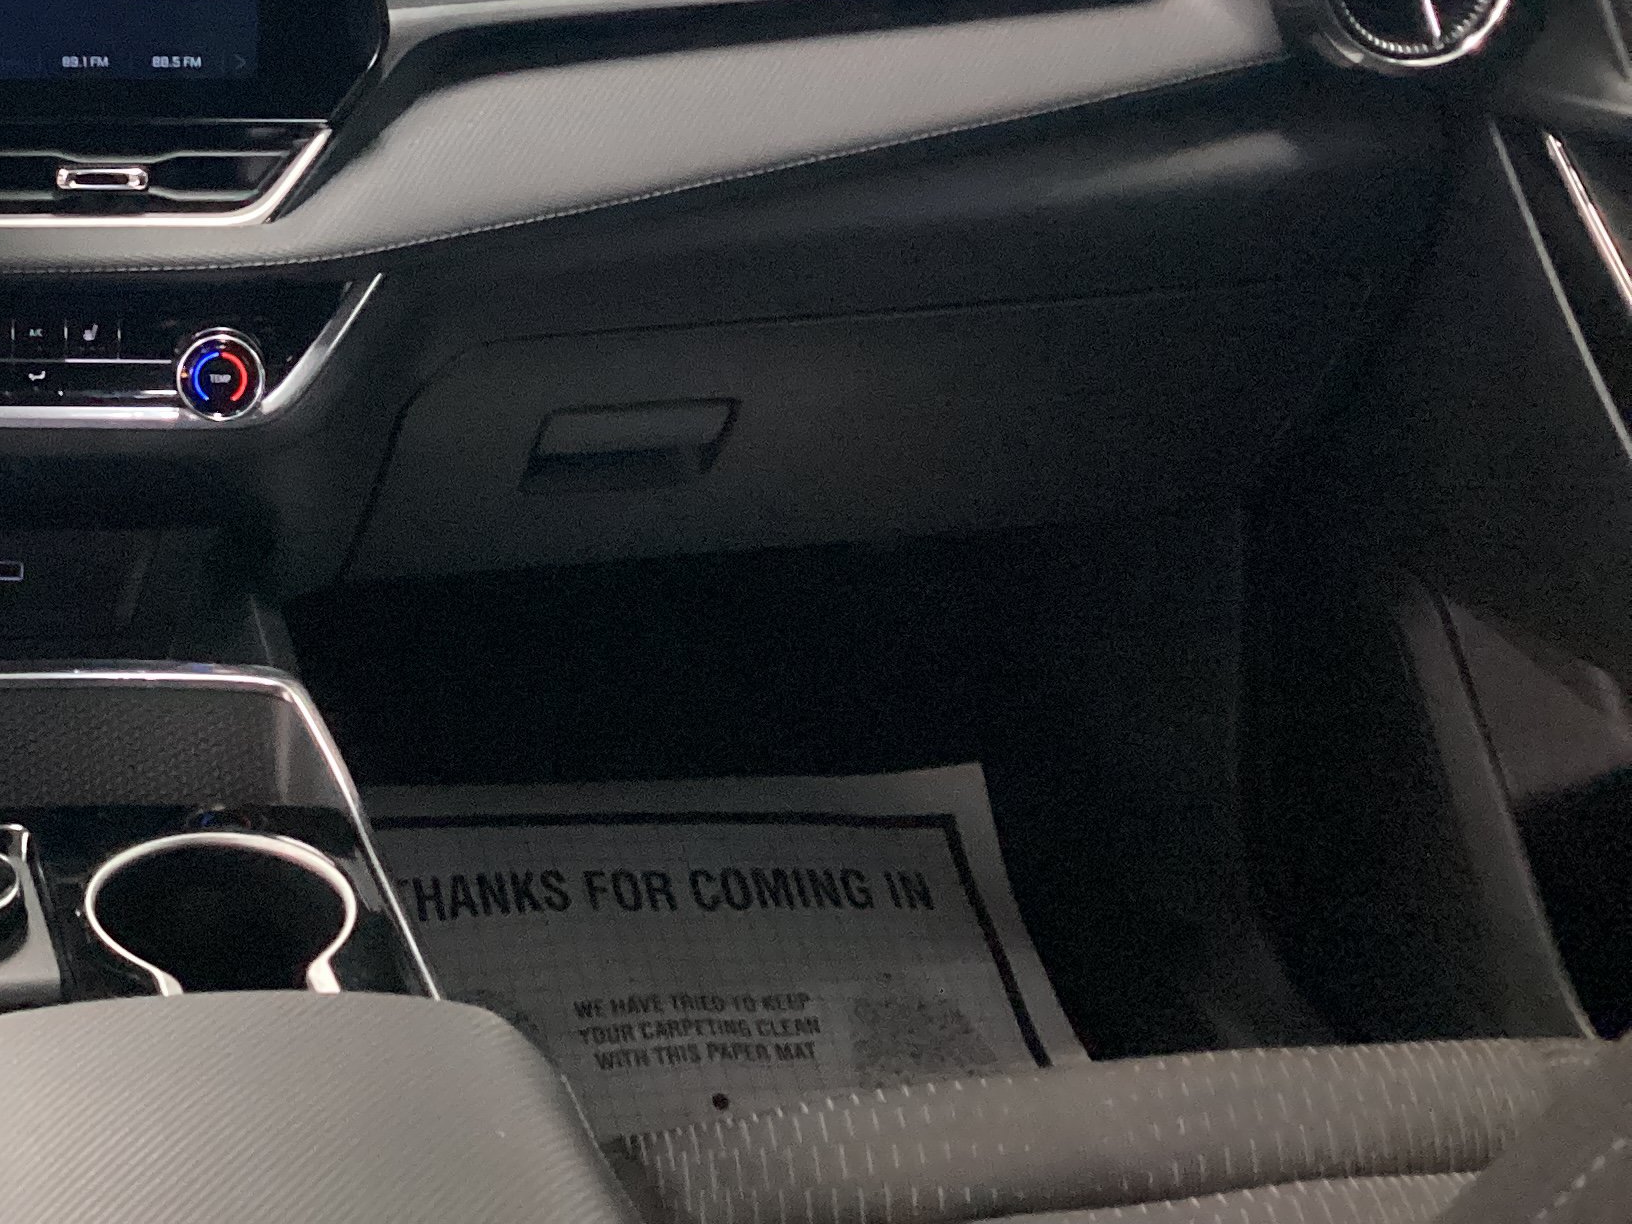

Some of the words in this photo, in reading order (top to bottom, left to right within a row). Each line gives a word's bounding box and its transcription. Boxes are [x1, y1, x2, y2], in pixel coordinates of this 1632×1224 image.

[89, 55, 109, 68] FM
[183, 55, 202, 68] FM
[583, 869, 679, 912] FOR
[689, 867, 875, 911] COMING
[883, 870, 935, 911] IN
[573, 998, 604, 1018] WE
[610, 994, 666, 1015] HAVE
[671, 991, 725, 1012] TRIED
[732, 993, 757, 1012] TO
[578, 1023, 637, 1045] YOUR
[638, 1018, 753, 1041] CARPETING
[755, 1016, 821, 1038] CLEAN
[593, 1047, 650, 1070] WITH
[653, 1042, 702, 1065] THIS
[706, 1040, 771, 1062] PAPER
[773, 1040, 816, 1062] MAT
